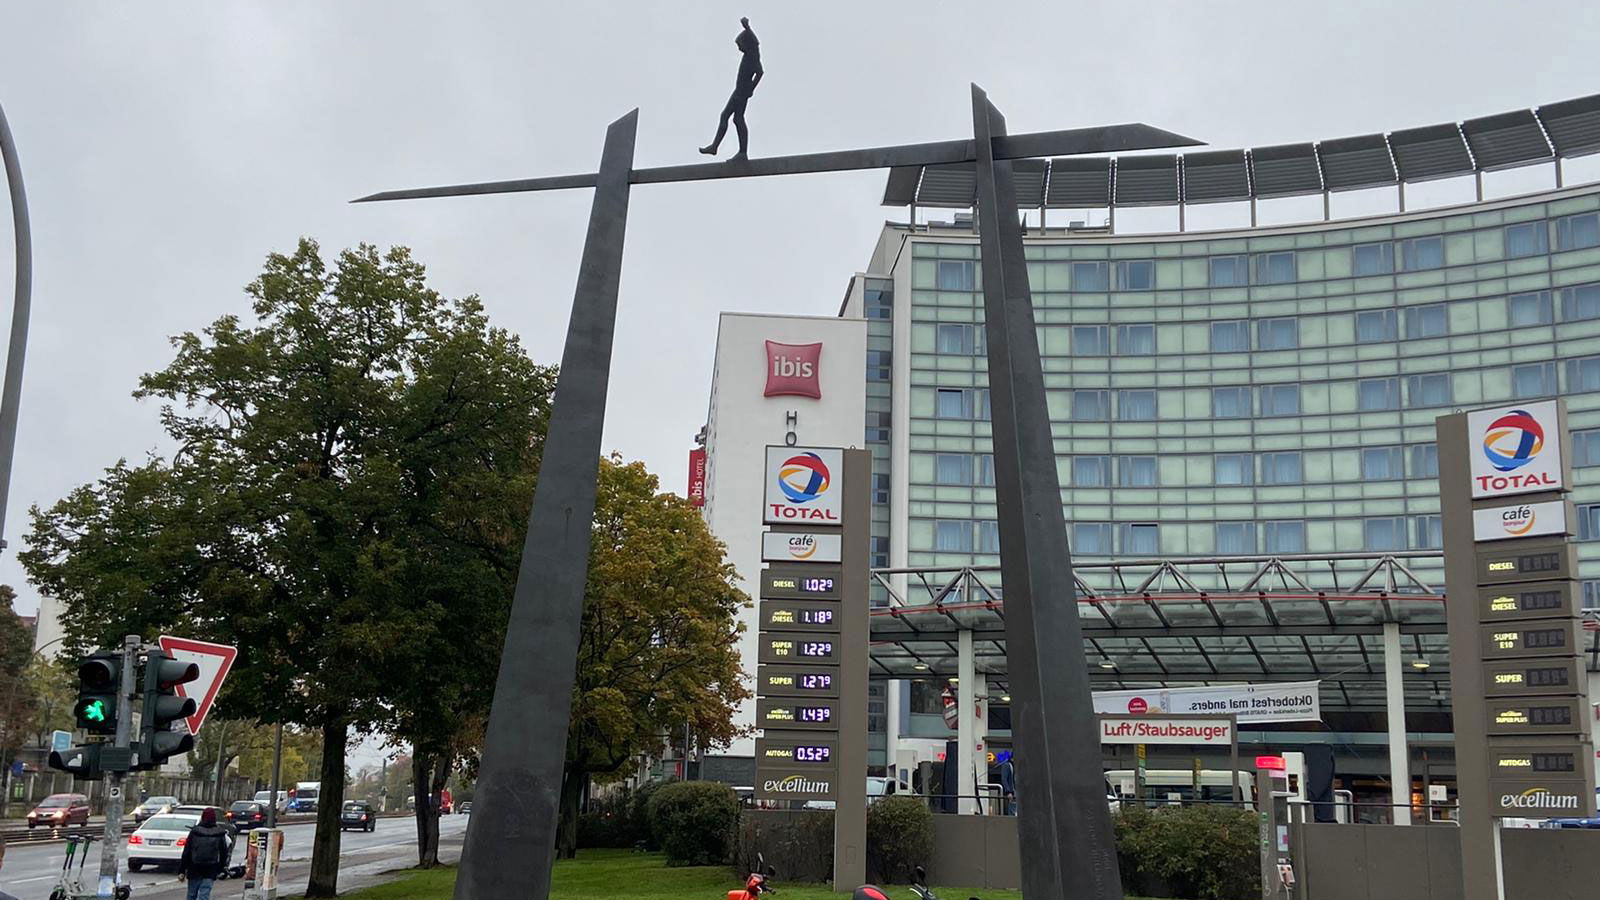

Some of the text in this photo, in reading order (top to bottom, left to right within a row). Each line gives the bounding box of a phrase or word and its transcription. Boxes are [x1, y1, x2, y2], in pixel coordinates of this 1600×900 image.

[774, 356, 813, 377] ibis
[696, 457, 704, 479] HOTEL
[1476, 472, 1557, 491] TOTAL
[770, 504, 838, 520] TOTAL
[1502, 506, 1531, 520] café
[789, 535, 814, 546] café
[1489, 562, 1515, 571] DIESEL
[773, 580, 795, 588] DIESEL
[1491, 602, 1517, 611] DIESEL
[771, 615, 793, 623] DIESEL
[1493, 632, 1518, 641] SUPER
[771, 641, 792, 649] SUPER
[1499, 641, 1514, 649] E10
[775, 648, 788, 656] E10
[769, 676, 792, 685] SUPER
[1495, 674, 1523, 683] SUPER
[1103, 722, 1229, 741] Luft/Staubsauger
[765, 749, 793, 757] AUTOGAS
[1499, 758, 1531, 767] AUTOGAS
[764, 777, 829, 793] excellium
[1500, 791, 1578, 809] excellium
